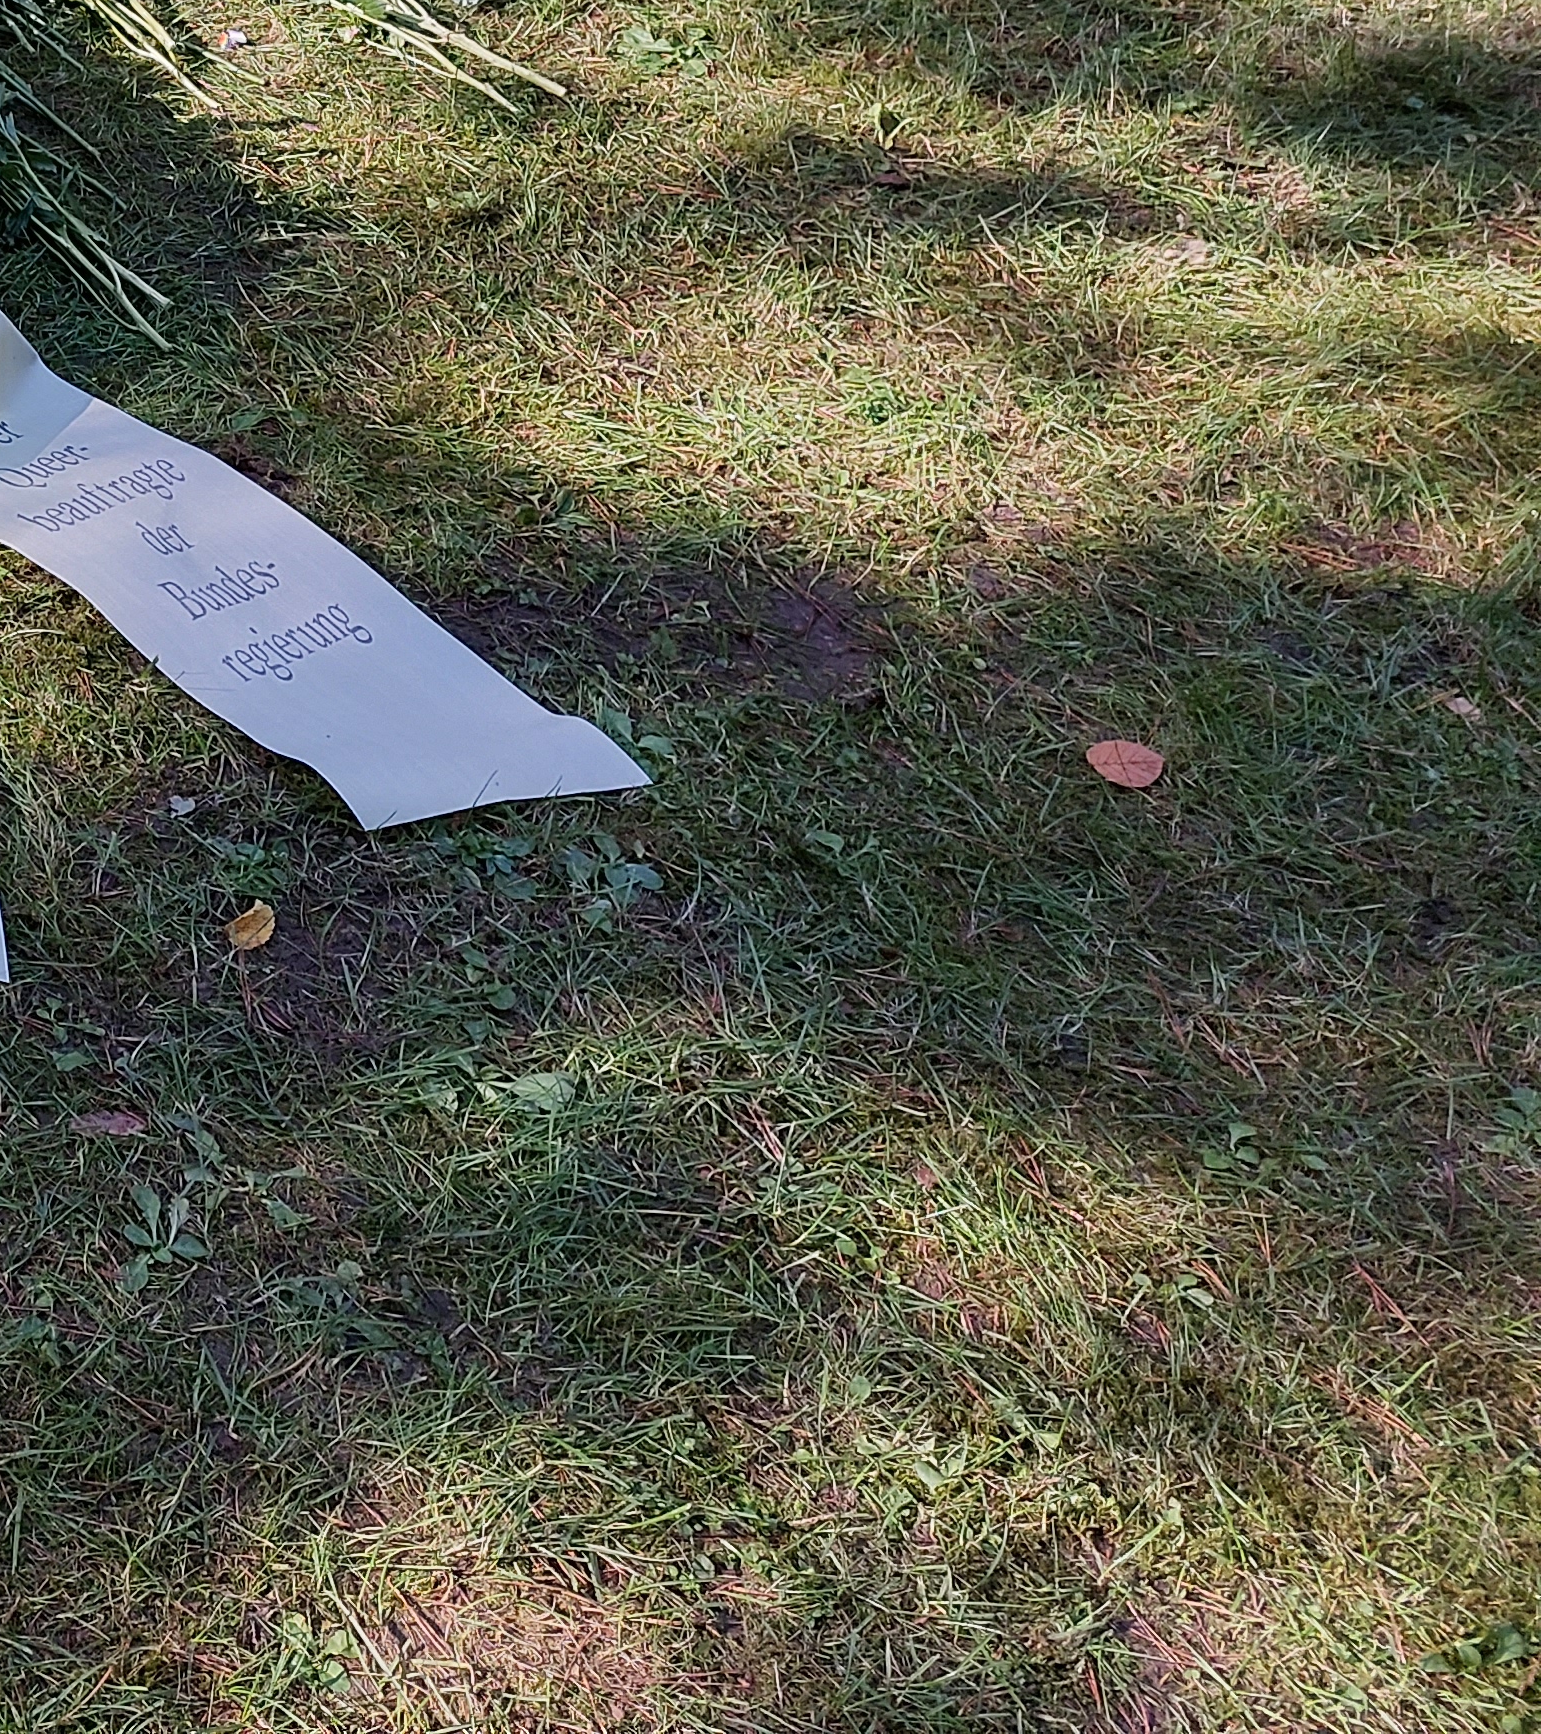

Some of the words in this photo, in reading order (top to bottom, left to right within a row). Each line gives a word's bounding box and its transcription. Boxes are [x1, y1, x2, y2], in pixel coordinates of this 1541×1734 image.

[17, 456, 186, 533] beauftragte
[135, 521, 195, 556] der
[157, 559, 280, 621] Bundes-
[220, 602, 374, 683] regierung
